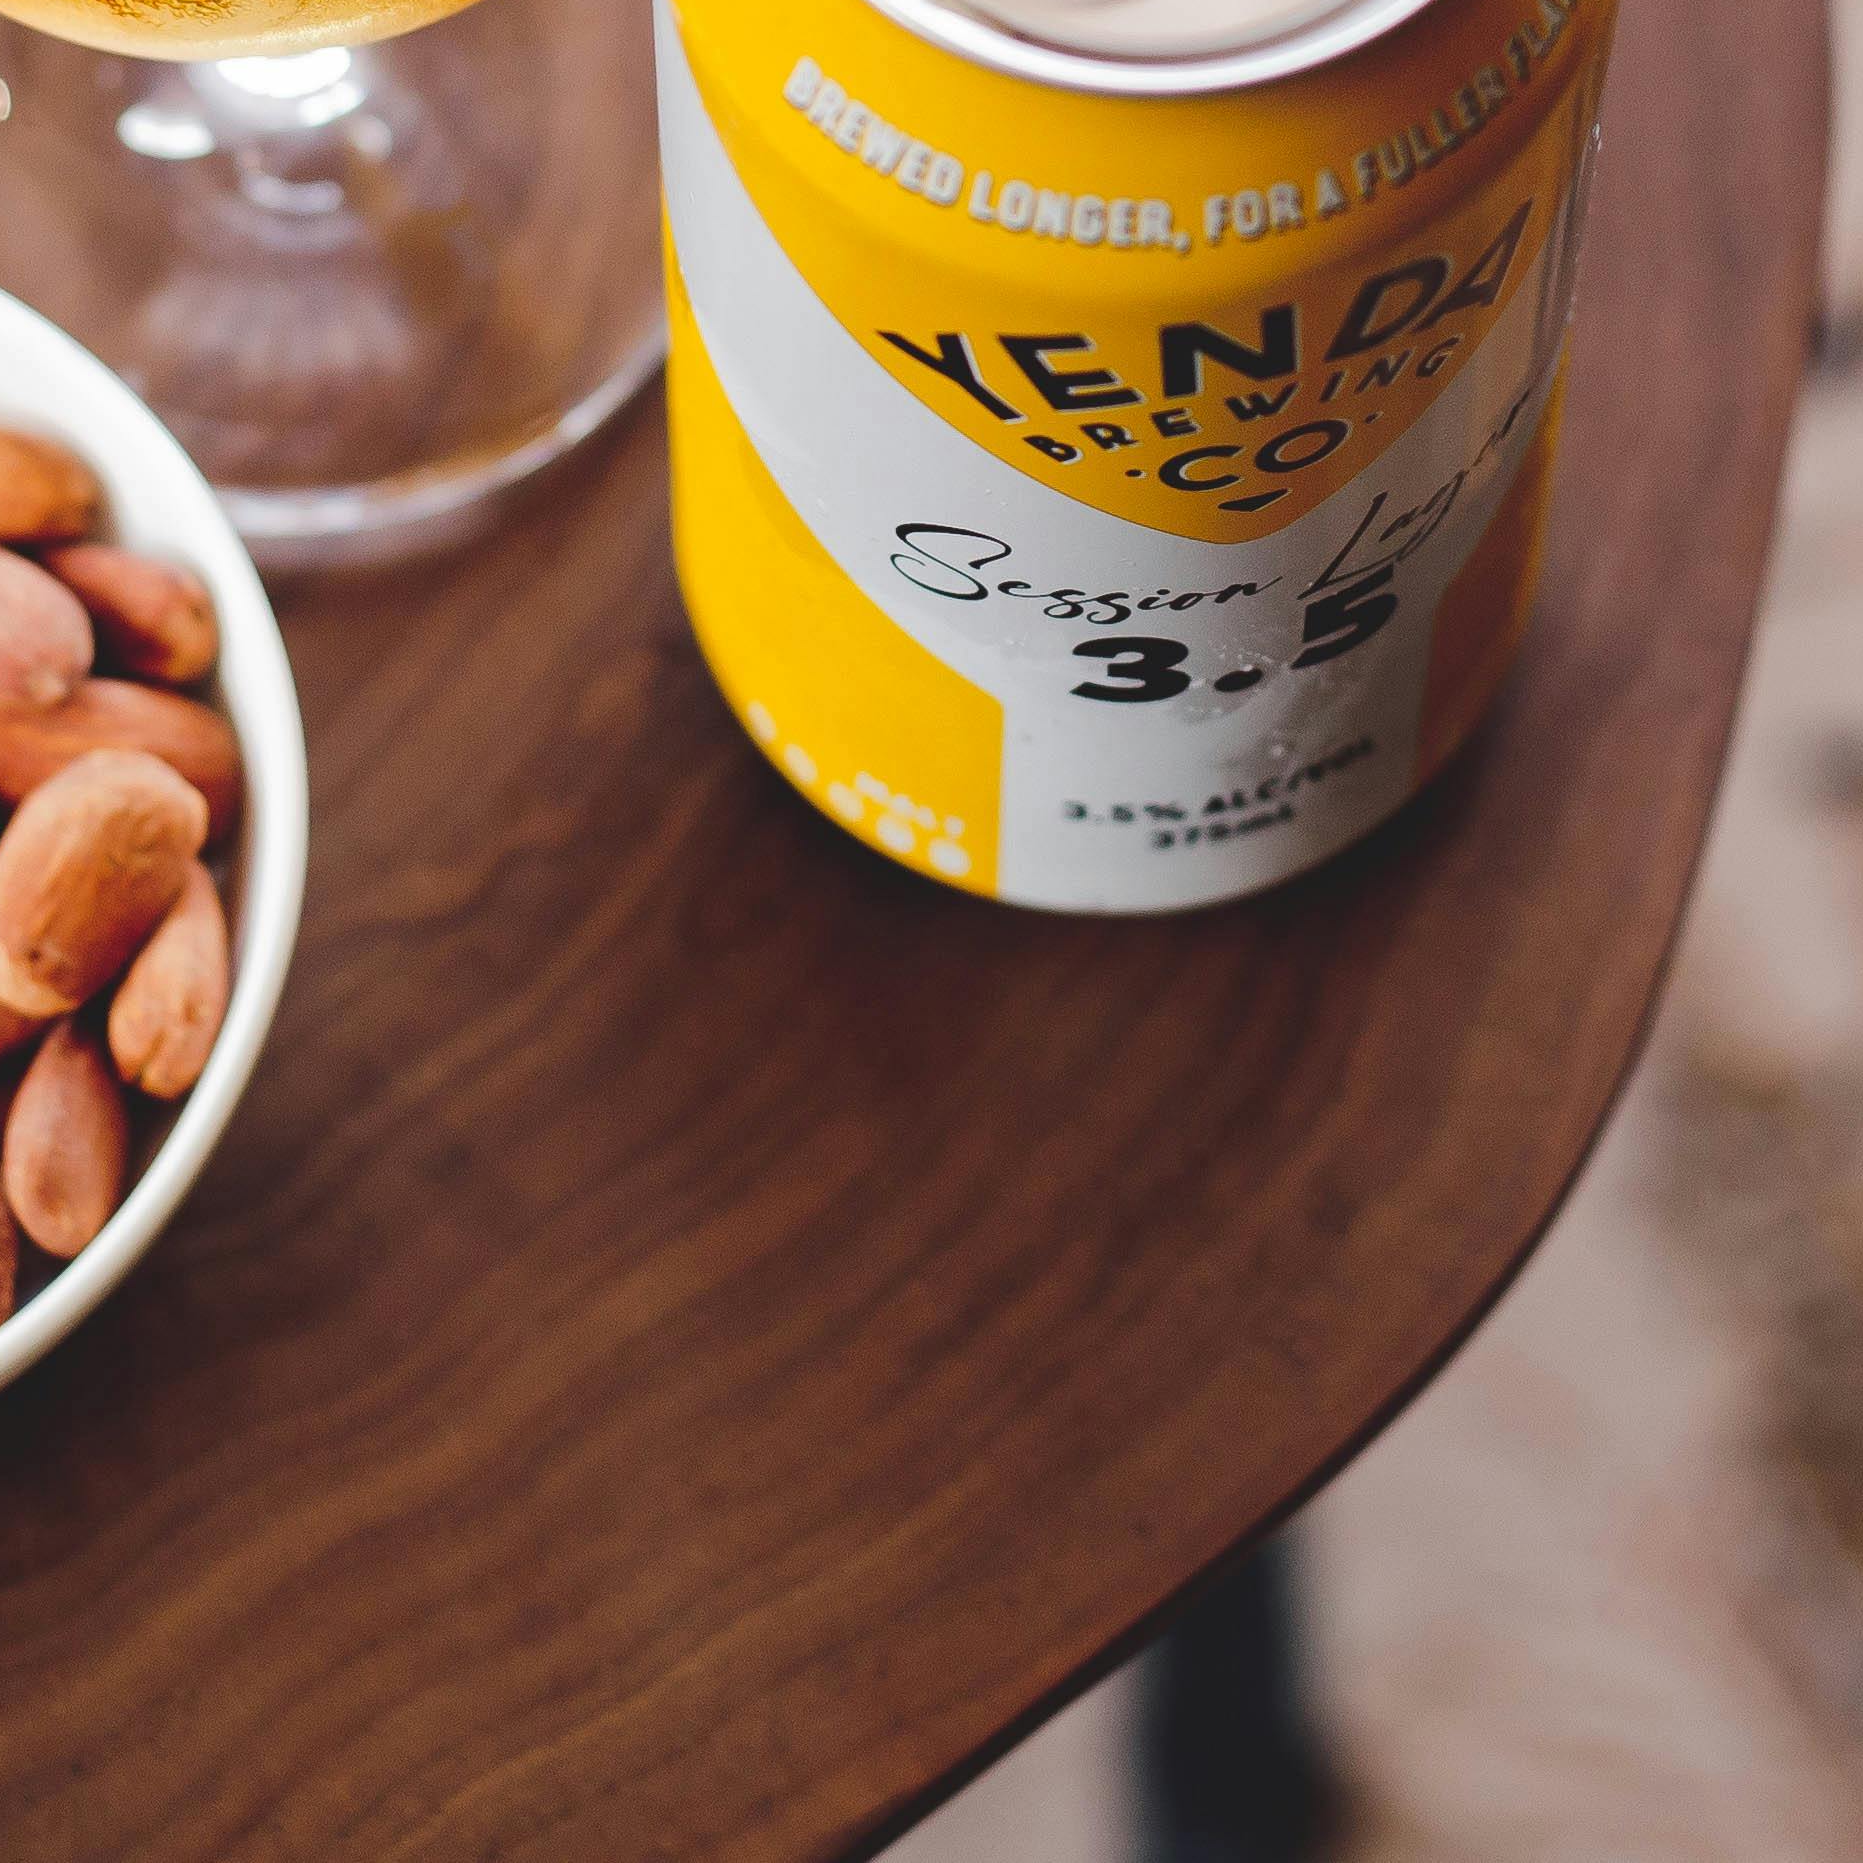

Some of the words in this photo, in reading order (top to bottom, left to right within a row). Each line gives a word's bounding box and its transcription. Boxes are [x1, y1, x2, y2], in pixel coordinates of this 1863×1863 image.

[783, 55, 964, 206] BREWED
[968, 170, 1192, 254] LONGER,
[1203, 182, 1304, 242] FOR
[1315, 168, 1346, 219] A
[1353, 65, 1509, 199] FULLER
[876, 196, 1534, 422] YENDA
[1022, 335, 1464, 464] BREWING
[890, 522, 1285, 626] Session
[1069, 561, 1399, 704] 3.5
